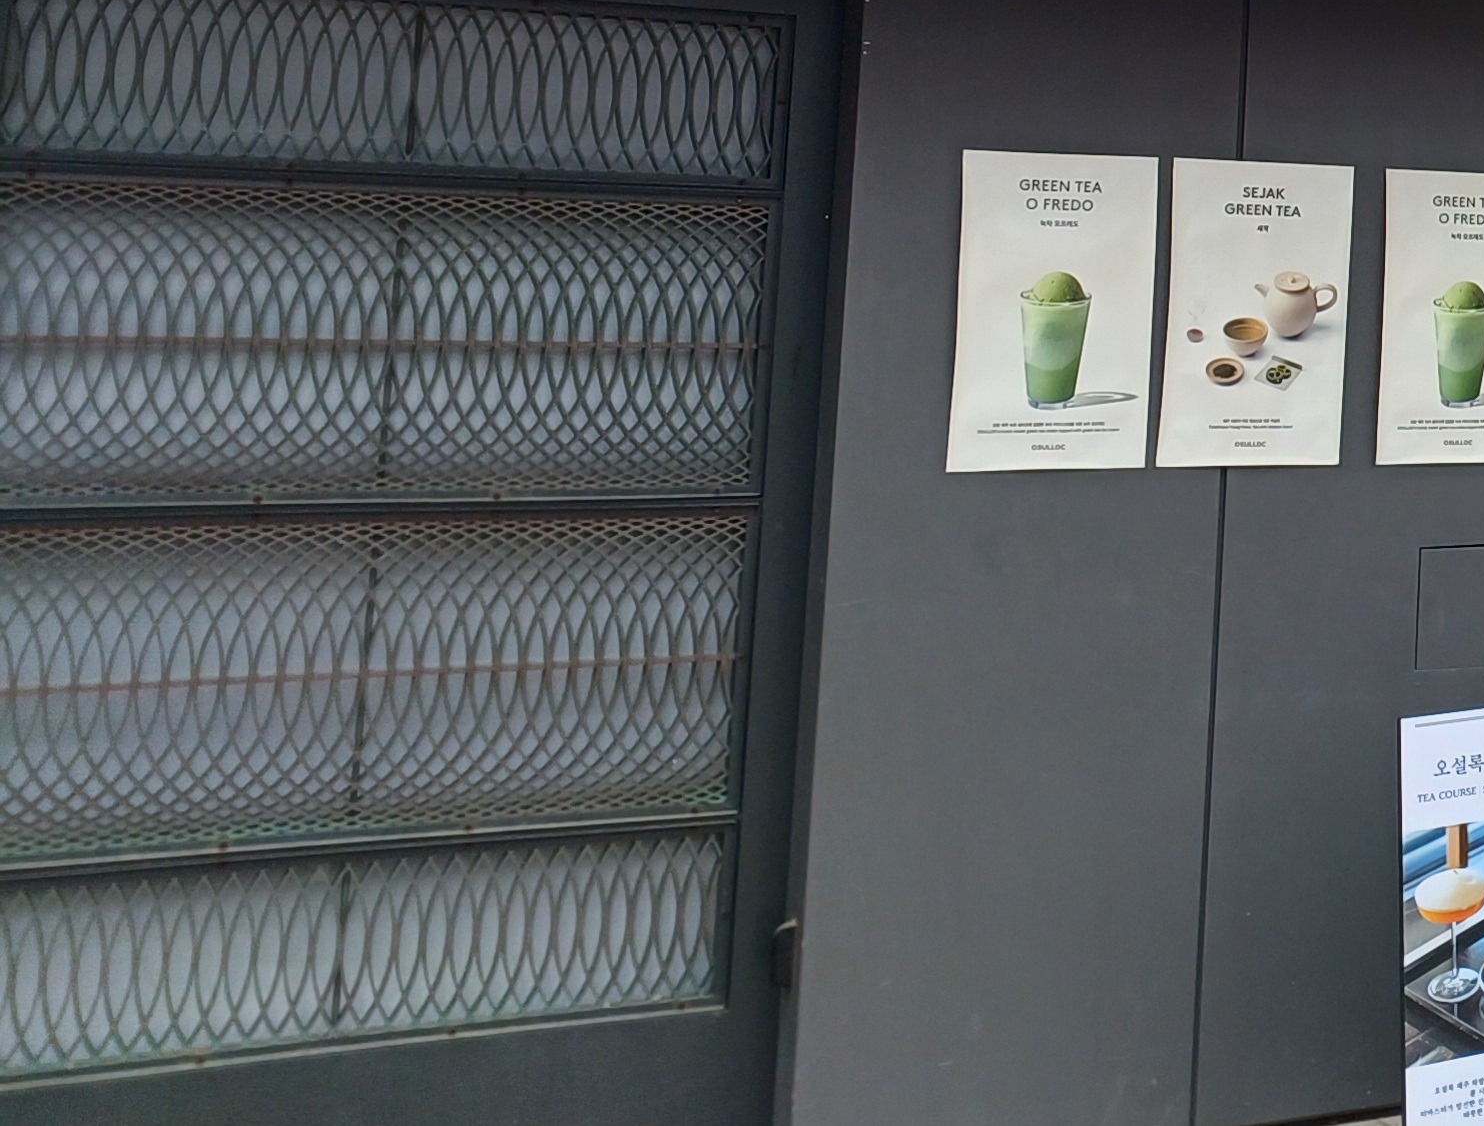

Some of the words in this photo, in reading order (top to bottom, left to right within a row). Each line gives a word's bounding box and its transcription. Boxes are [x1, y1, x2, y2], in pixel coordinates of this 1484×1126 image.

[1019, 179, 1070, 192] GREEN
[1075, 180, 1102, 193] TEA
[1242, 187, 1285, 200] SEJAK
[1026, 198, 1038, 210] O
[1043, 198, 1094, 211] FREDO
[1432, 195, 1476, 208] GREEN
[1224, 203, 1272, 216] GREEN
[1276, 205, 1301, 217] TEA
[1439, 213, 1450, 224] O
[1433, 754, 1484, 777] 오설록
[1416, 793, 1436, 803] TEA
[1438, 786, 1477, 800] COURSE
